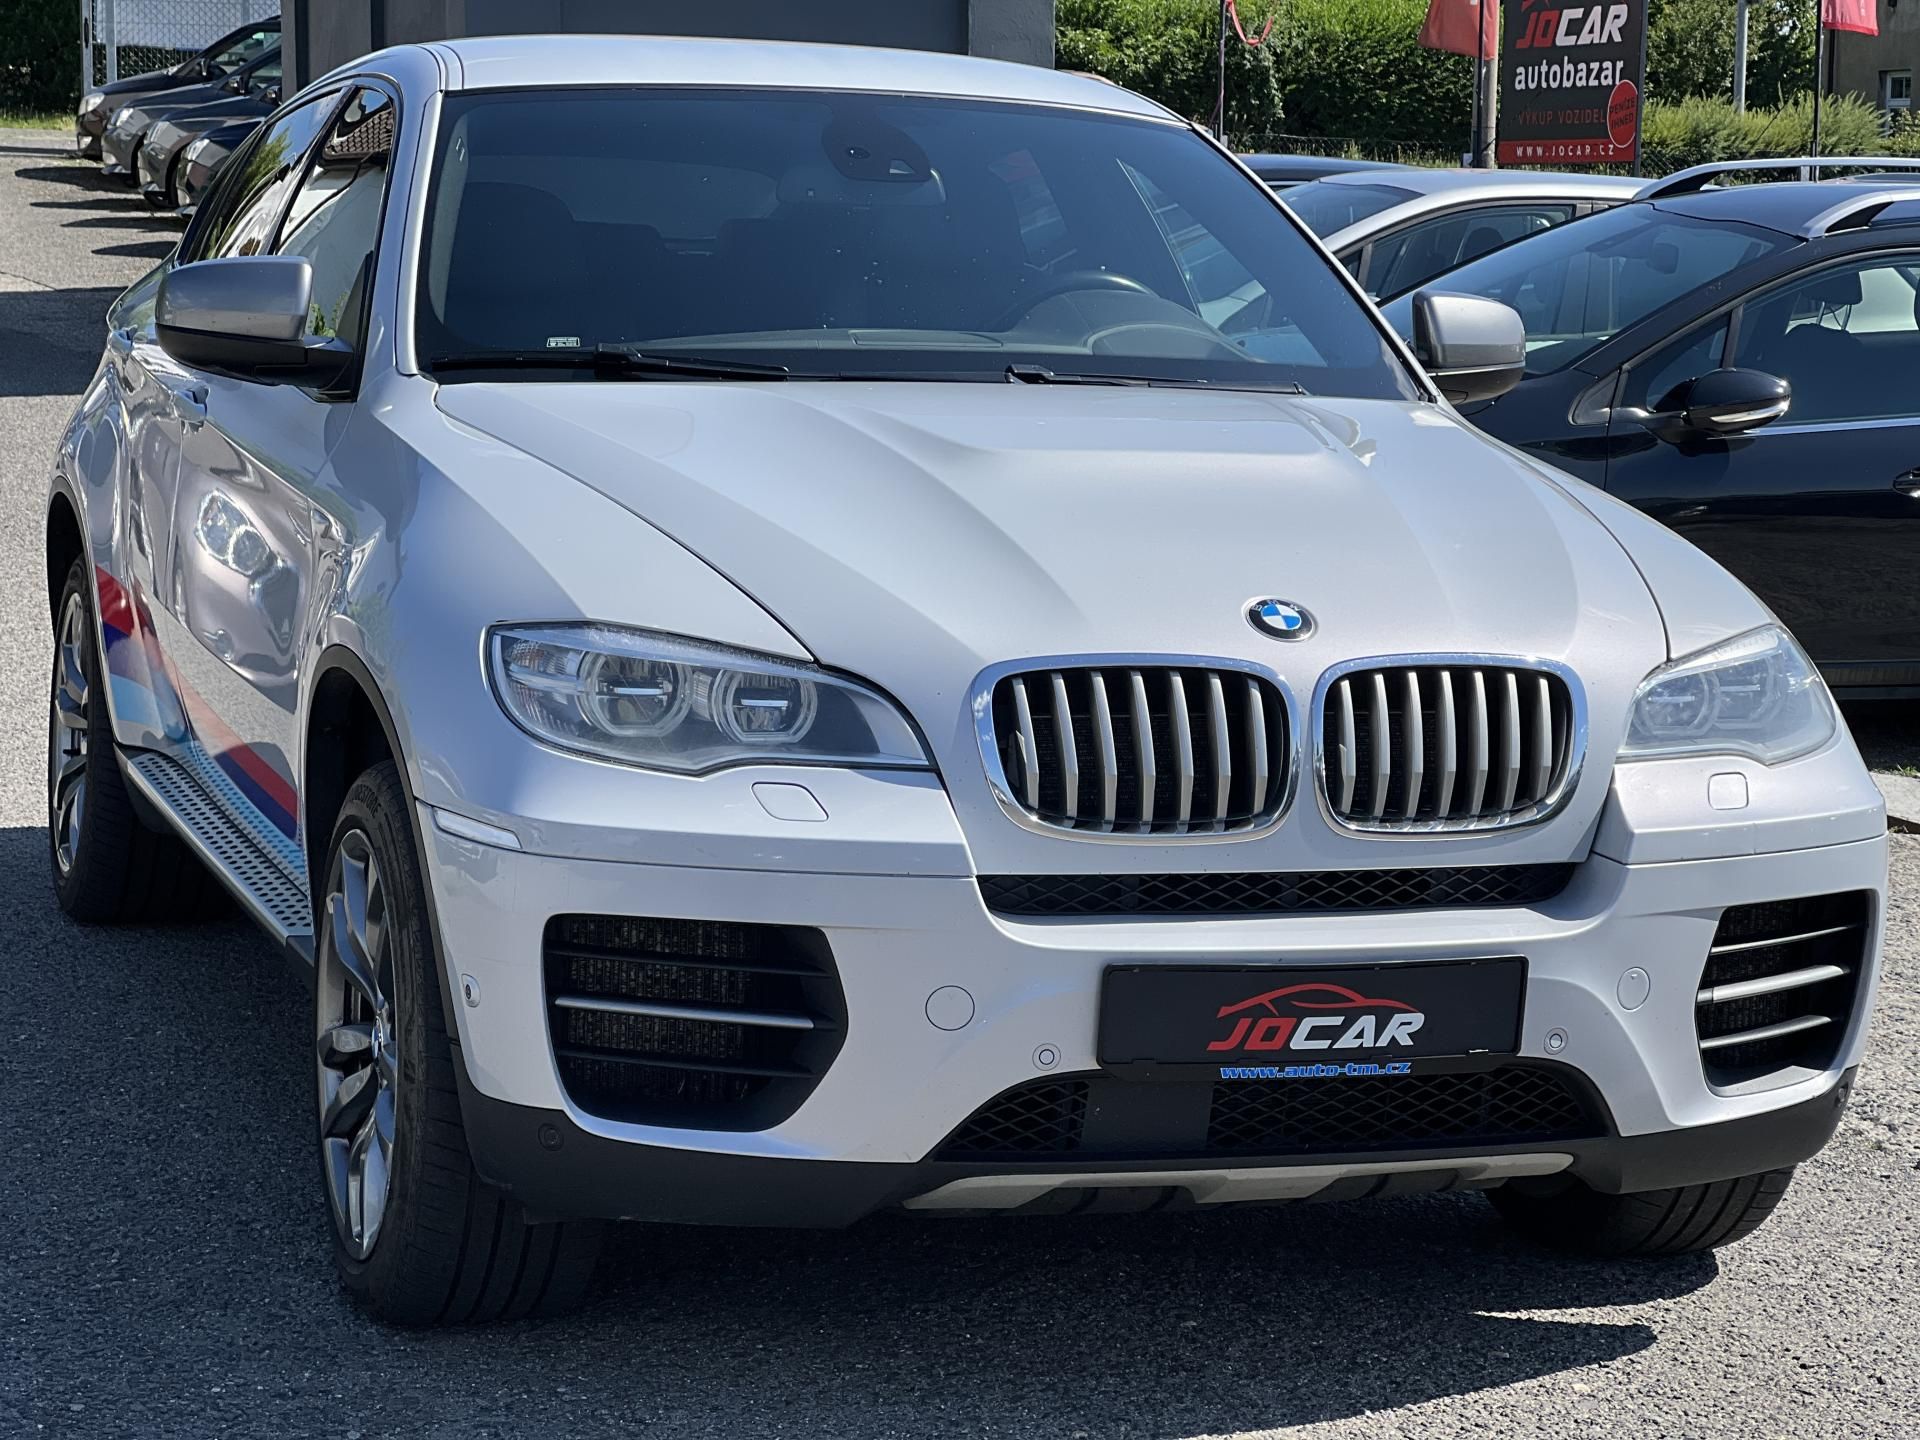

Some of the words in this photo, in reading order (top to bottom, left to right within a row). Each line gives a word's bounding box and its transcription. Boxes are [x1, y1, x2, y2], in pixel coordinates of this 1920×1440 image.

[1515, 4, 1628, 48] JOCAR
[1514, 56, 1624, 91] autobazar
[1558, 109, 1605, 125] VOZIDEL
[1516, 144, 1614, 157] WWW.JOCAR.CZ
[1206, 1012, 1425, 1051] JOCAR
[1220, 1062, 1412, 1079] www.auto-tm.cz
